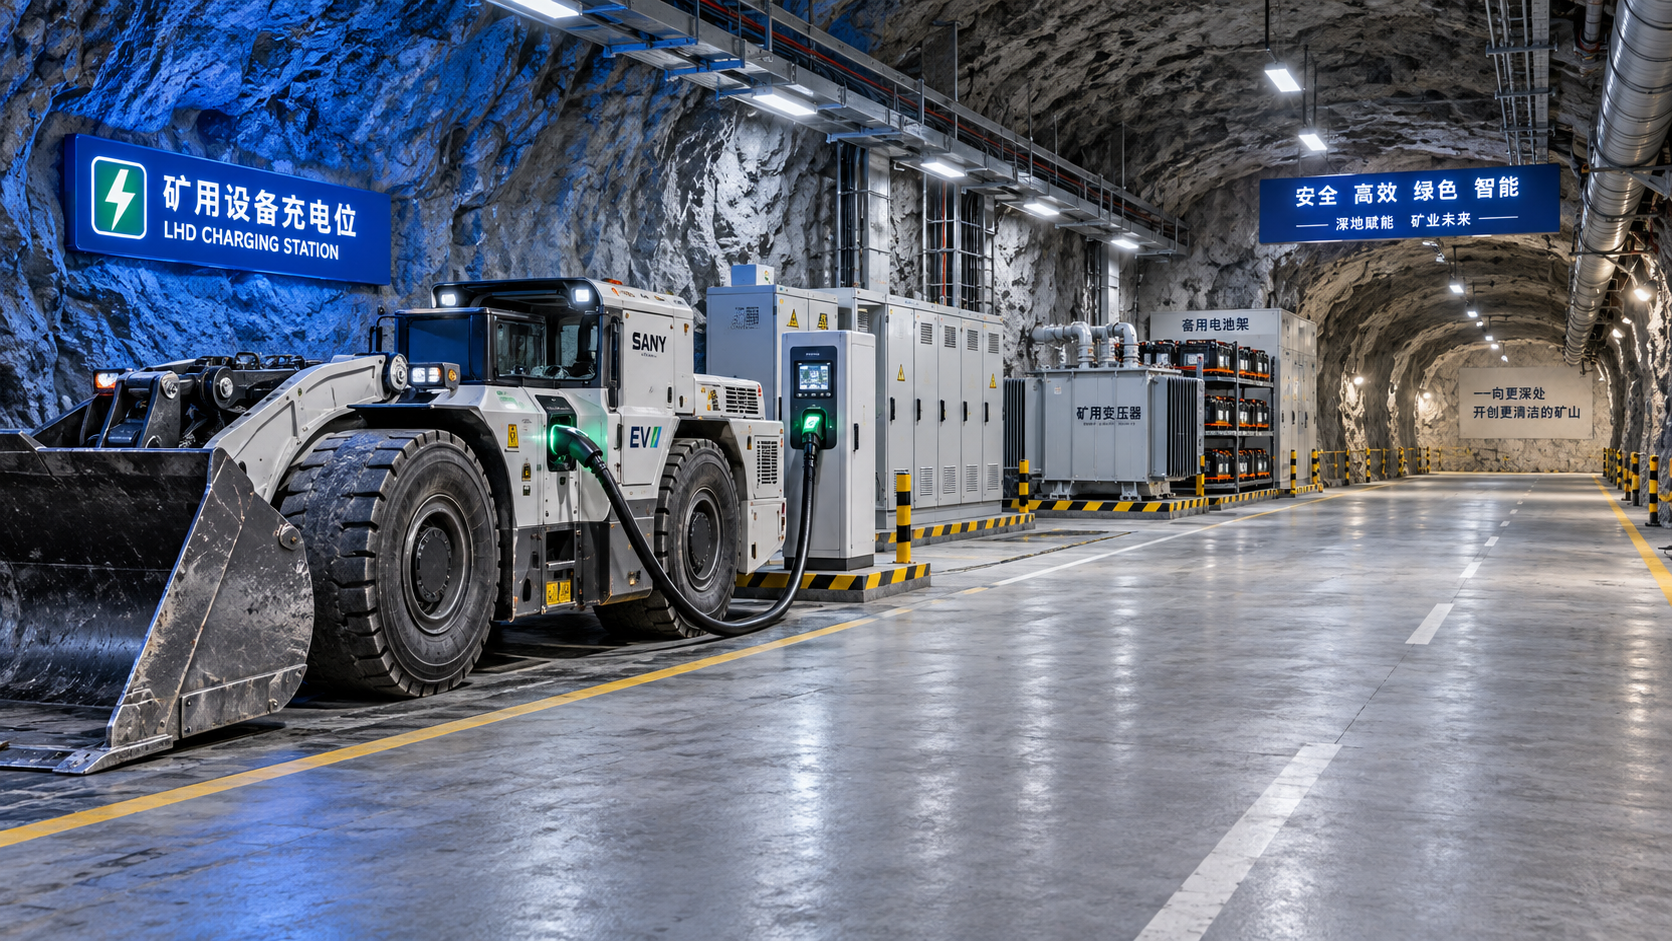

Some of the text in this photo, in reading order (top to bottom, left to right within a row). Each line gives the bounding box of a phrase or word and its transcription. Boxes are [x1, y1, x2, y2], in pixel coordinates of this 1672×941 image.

[1295, 176, 1519, 207] 安全 高效 绿色 智能
[163, 174, 357, 238] 矿用设备充电位
[1335, 211, 1471, 231] 深地赋能 矿业未来
[164, 220, 339, 260] LHD CHARGING STATION
[632, 331, 667, 353] SANY
[1076, 405, 1141, 420] 矿用变压器
